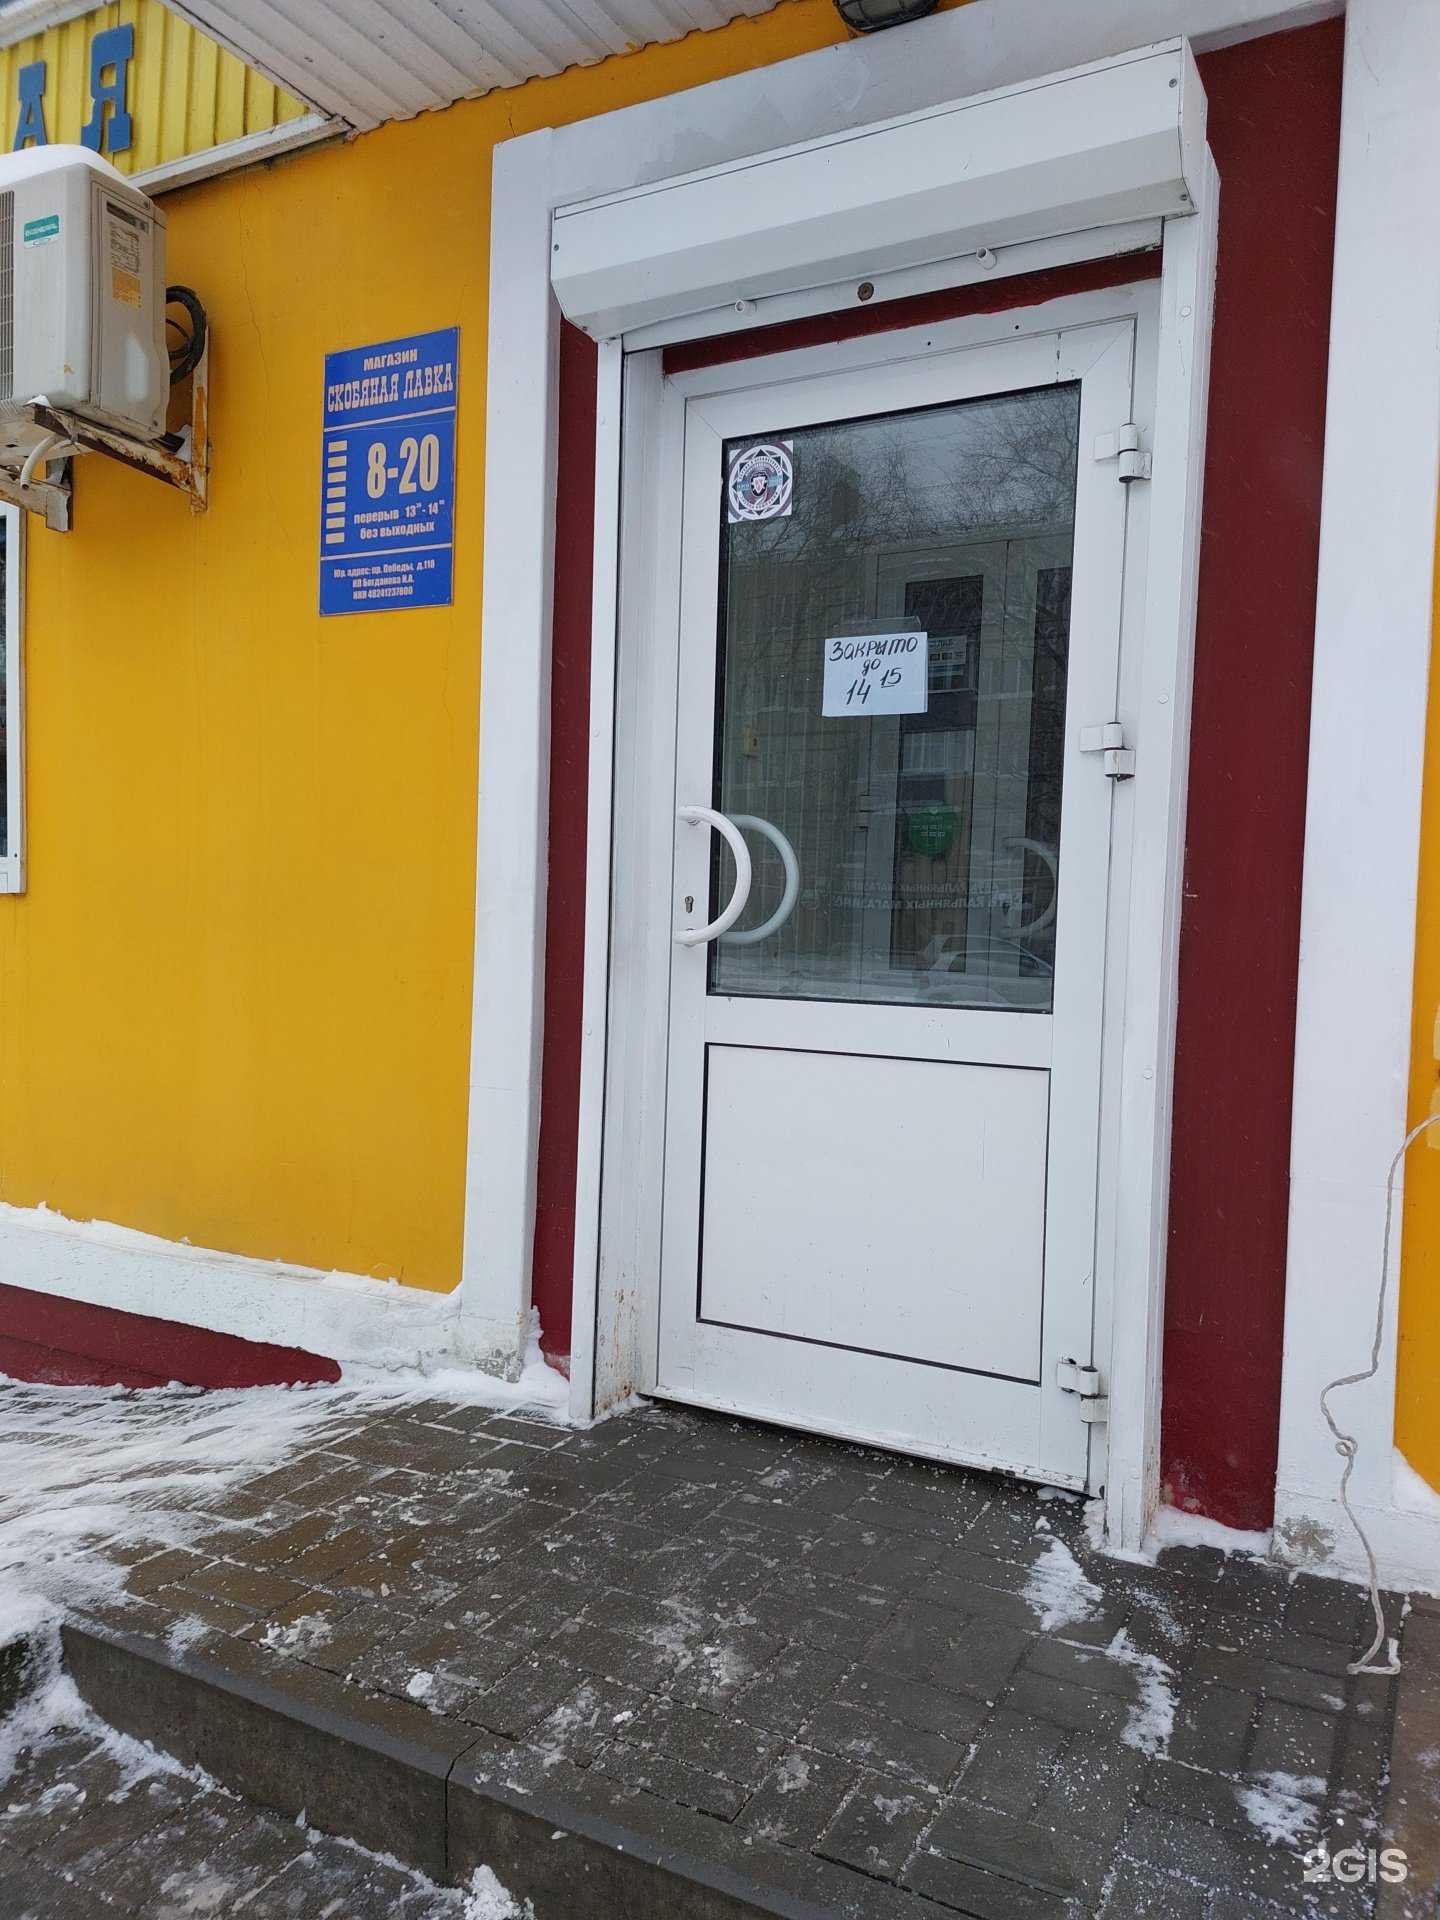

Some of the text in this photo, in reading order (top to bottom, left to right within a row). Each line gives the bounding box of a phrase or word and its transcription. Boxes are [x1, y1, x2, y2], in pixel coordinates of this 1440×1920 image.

[364, 349, 417, 371] МАГАЗИН
[328, 363, 453, 412] СКОБЯНАЯ ЛАВКА
[368, 434, 439, 499] 8-20
[354, 510, 399, 524] перерыв
[360, 522, 434, 539] без выходных
[846, 678, 871, 705] 14
